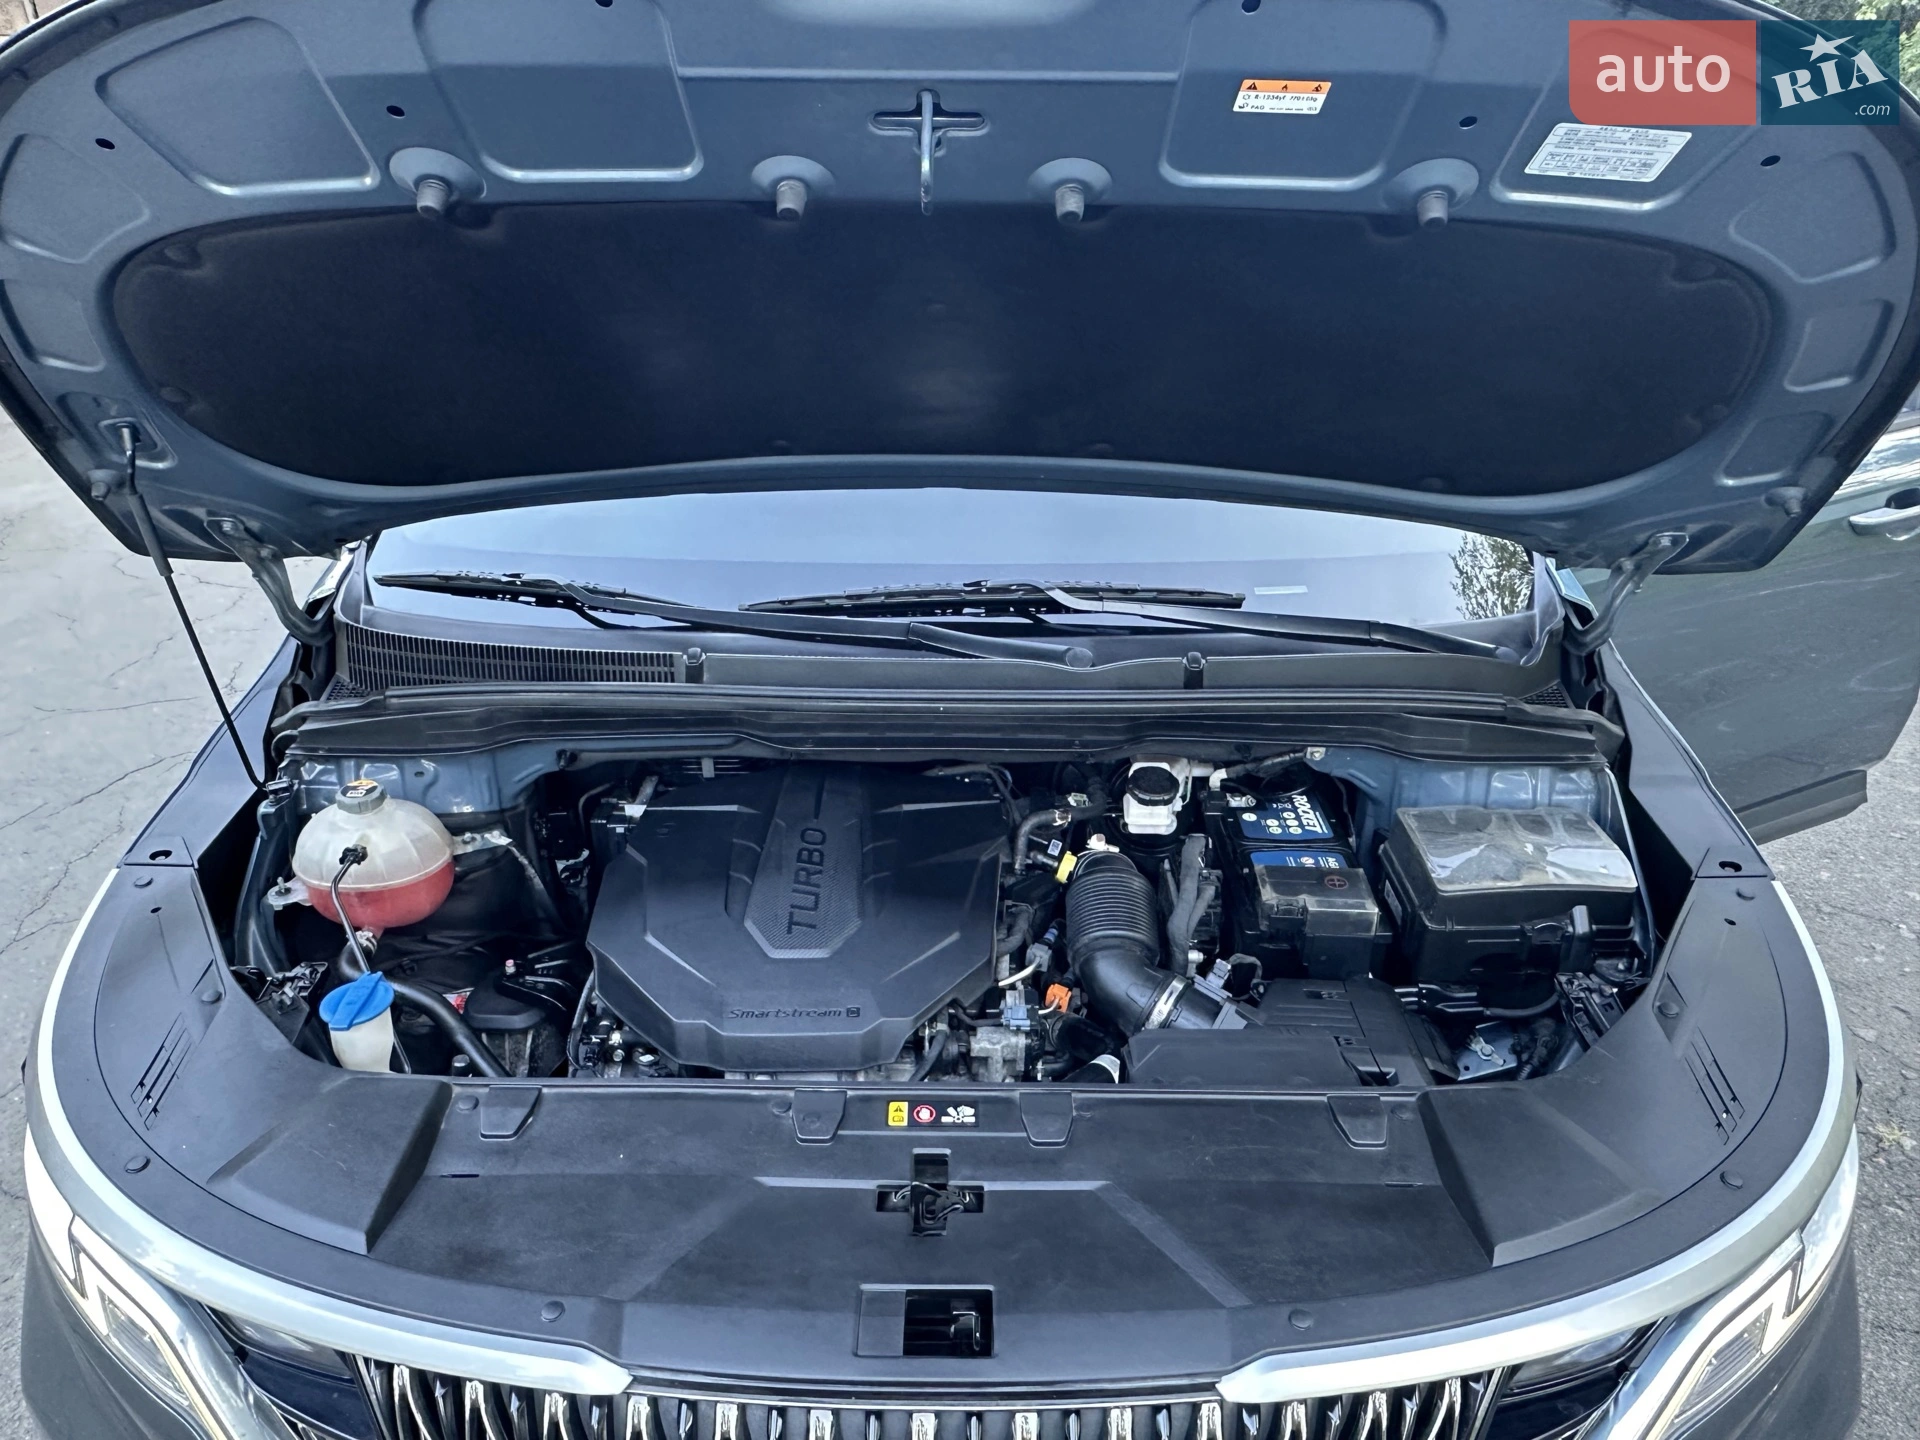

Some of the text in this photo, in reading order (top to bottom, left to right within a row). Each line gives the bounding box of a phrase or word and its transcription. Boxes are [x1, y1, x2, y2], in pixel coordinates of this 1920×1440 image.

[1291, 794, 1323, 834] ROCKET
[787, 827, 826, 935] TURBO
[729, 1006, 842, 1019] Smartstream
